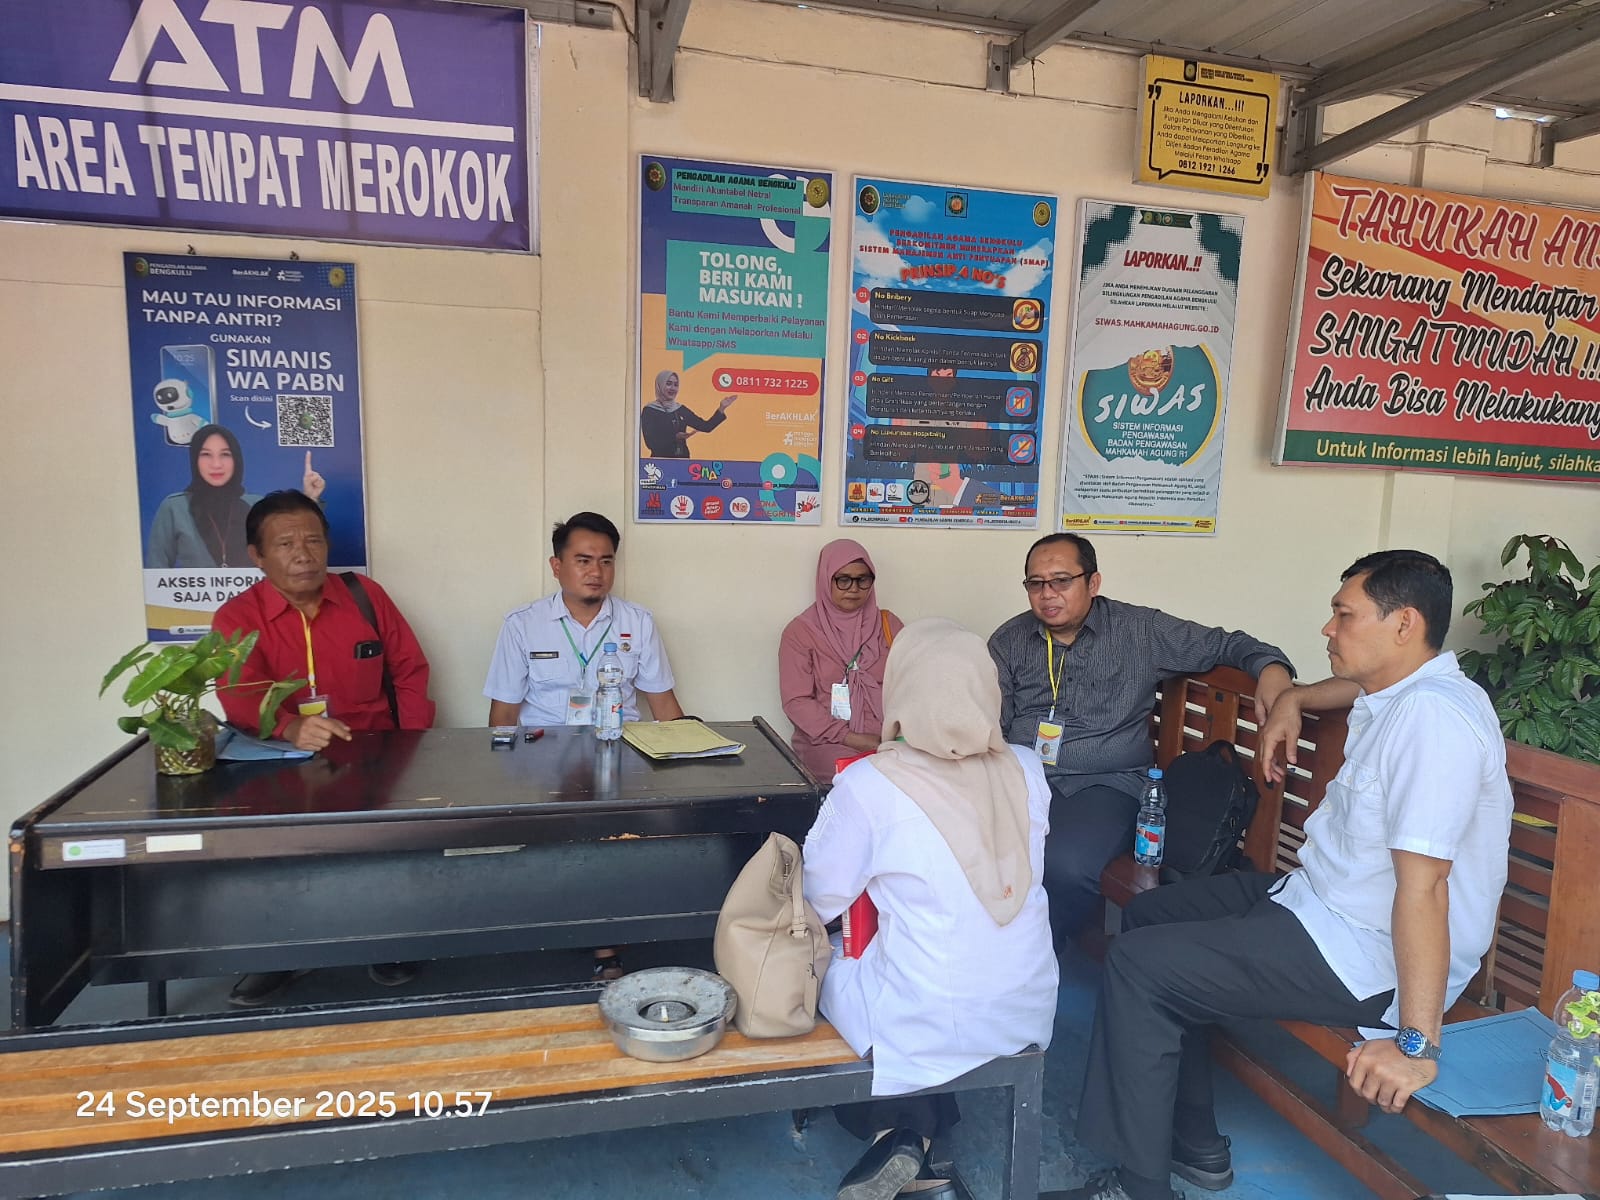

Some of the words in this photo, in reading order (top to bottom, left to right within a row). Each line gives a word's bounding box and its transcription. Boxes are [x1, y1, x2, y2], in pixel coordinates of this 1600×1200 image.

[110, 0, 414, 107] ATM
[1183, 126, 1212, 135] Pelayanan
[1214, 131, 1227, 139] yang
[1209, 121, 1224, 129] yang
[1174, 133, 1191, 141] dapat
[1203, 146, 1228, 154] Peradilan
[1231, 150, 1250, 158] Agama
[14, 114, 136, 197] AREA
[139, 124, 304, 209] TEMPAT
[317, 139, 514, 223] MEROKOK
[1179, 160, 1196, 169] 0812
[1199, 162, 1215, 172] 1921
[1219, 165, 1235, 175] 1266
[676, 171, 726, 184] PENGADILAN
[728, 176, 755, 187] AGAMA
[758, 179, 796, 190] BENGKULU
[673, 183, 703, 193] Mandiri
[706, 184, 746, 196] Akuntabel
[748, 190, 771, 199] Netral
[673, 196, 718, 208] Transparan
[721, 201, 752, 210] Amanah
[757, 204, 801, 214] Profesional
[1333, 186, 1537, 261] TAHUKAH
[1544, 216, 1600, 268] AN
[700, 251, 782, 274] TOLONG,
[859, 245, 889, 254] SISTEM
[1020, 257, 1049, 268] (SMAP)
[700, 269, 739, 287] BERI
[745, 272, 792, 290] KAMI
[900, 263, 957, 282] PRINSIP
[142, 289, 187, 305] MAU
[192, 292, 231, 307] TAU
[237, 294, 340, 311] INFORMASI
[700, 287, 792, 308] MASUKAN
[886, 292, 912, 302] Bribery
[1317, 255, 1451, 316] Sekarang
[1461, 270, 1598, 330] Mendaftar
[142, 308, 210, 325] TANPA
[215, 312, 282, 327] ANTRI?
[669, 309, 694, 318] Bantu
[697, 310, 720, 320] Kami
[722, 312, 779, 324] Memperbaiki
[781, 316, 825, 327] Pelayanan
[1095, 318, 1220, 334] SIWAS.MAHKAMAHAGUNG.GO.ID
[210, 333, 271, 345] GUNAKAN
[669, 323, 691, 333] Kami
[694, 324, 726, 336] dengan
[729, 327, 779, 338] Melaporkan
[782, 329, 812, 340] Melalui
[669, 338, 736, 349] Whatsapp/SMS
[226, 348, 332, 370] SIMANIS
[226, 371, 270, 390] WA
[277, 372, 344, 392] PABN
[736, 377, 761, 387] 0811
[764, 377, 782, 388] 732
[785, 378, 809, 389] 1225
[1305, 365, 1378, 411] Anda
[1383, 372, 1445, 415] Bisa
[230, 394, 249, 402] Scan
[1094, 383, 1205, 423] SIWAS
[1112, 422, 1140, 430] SISTEM
[1143, 423, 1183, 432] INFORMASI
[1122, 431, 1175, 440] PENGAWASAN
[1105, 447, 1149, 456] MAHKAMAH
[1150, 449, 1177, 457] AGUNG
[1107, 439, 1134, 447] BADAN
[1135, 440, 1187, 449] PENGAWASAN
[1316, 438, 1366, 457] Untuk
[1371, 441, 1448, 463] Informasi
[1452, 447, 1491, 466] lebih
[1495, 449, 1544, 471] lanjut,
[157, 576, 206, 588] AKSES
[173, 591, 212, 603] SAJA
[216, 591, 240, 602] DA
